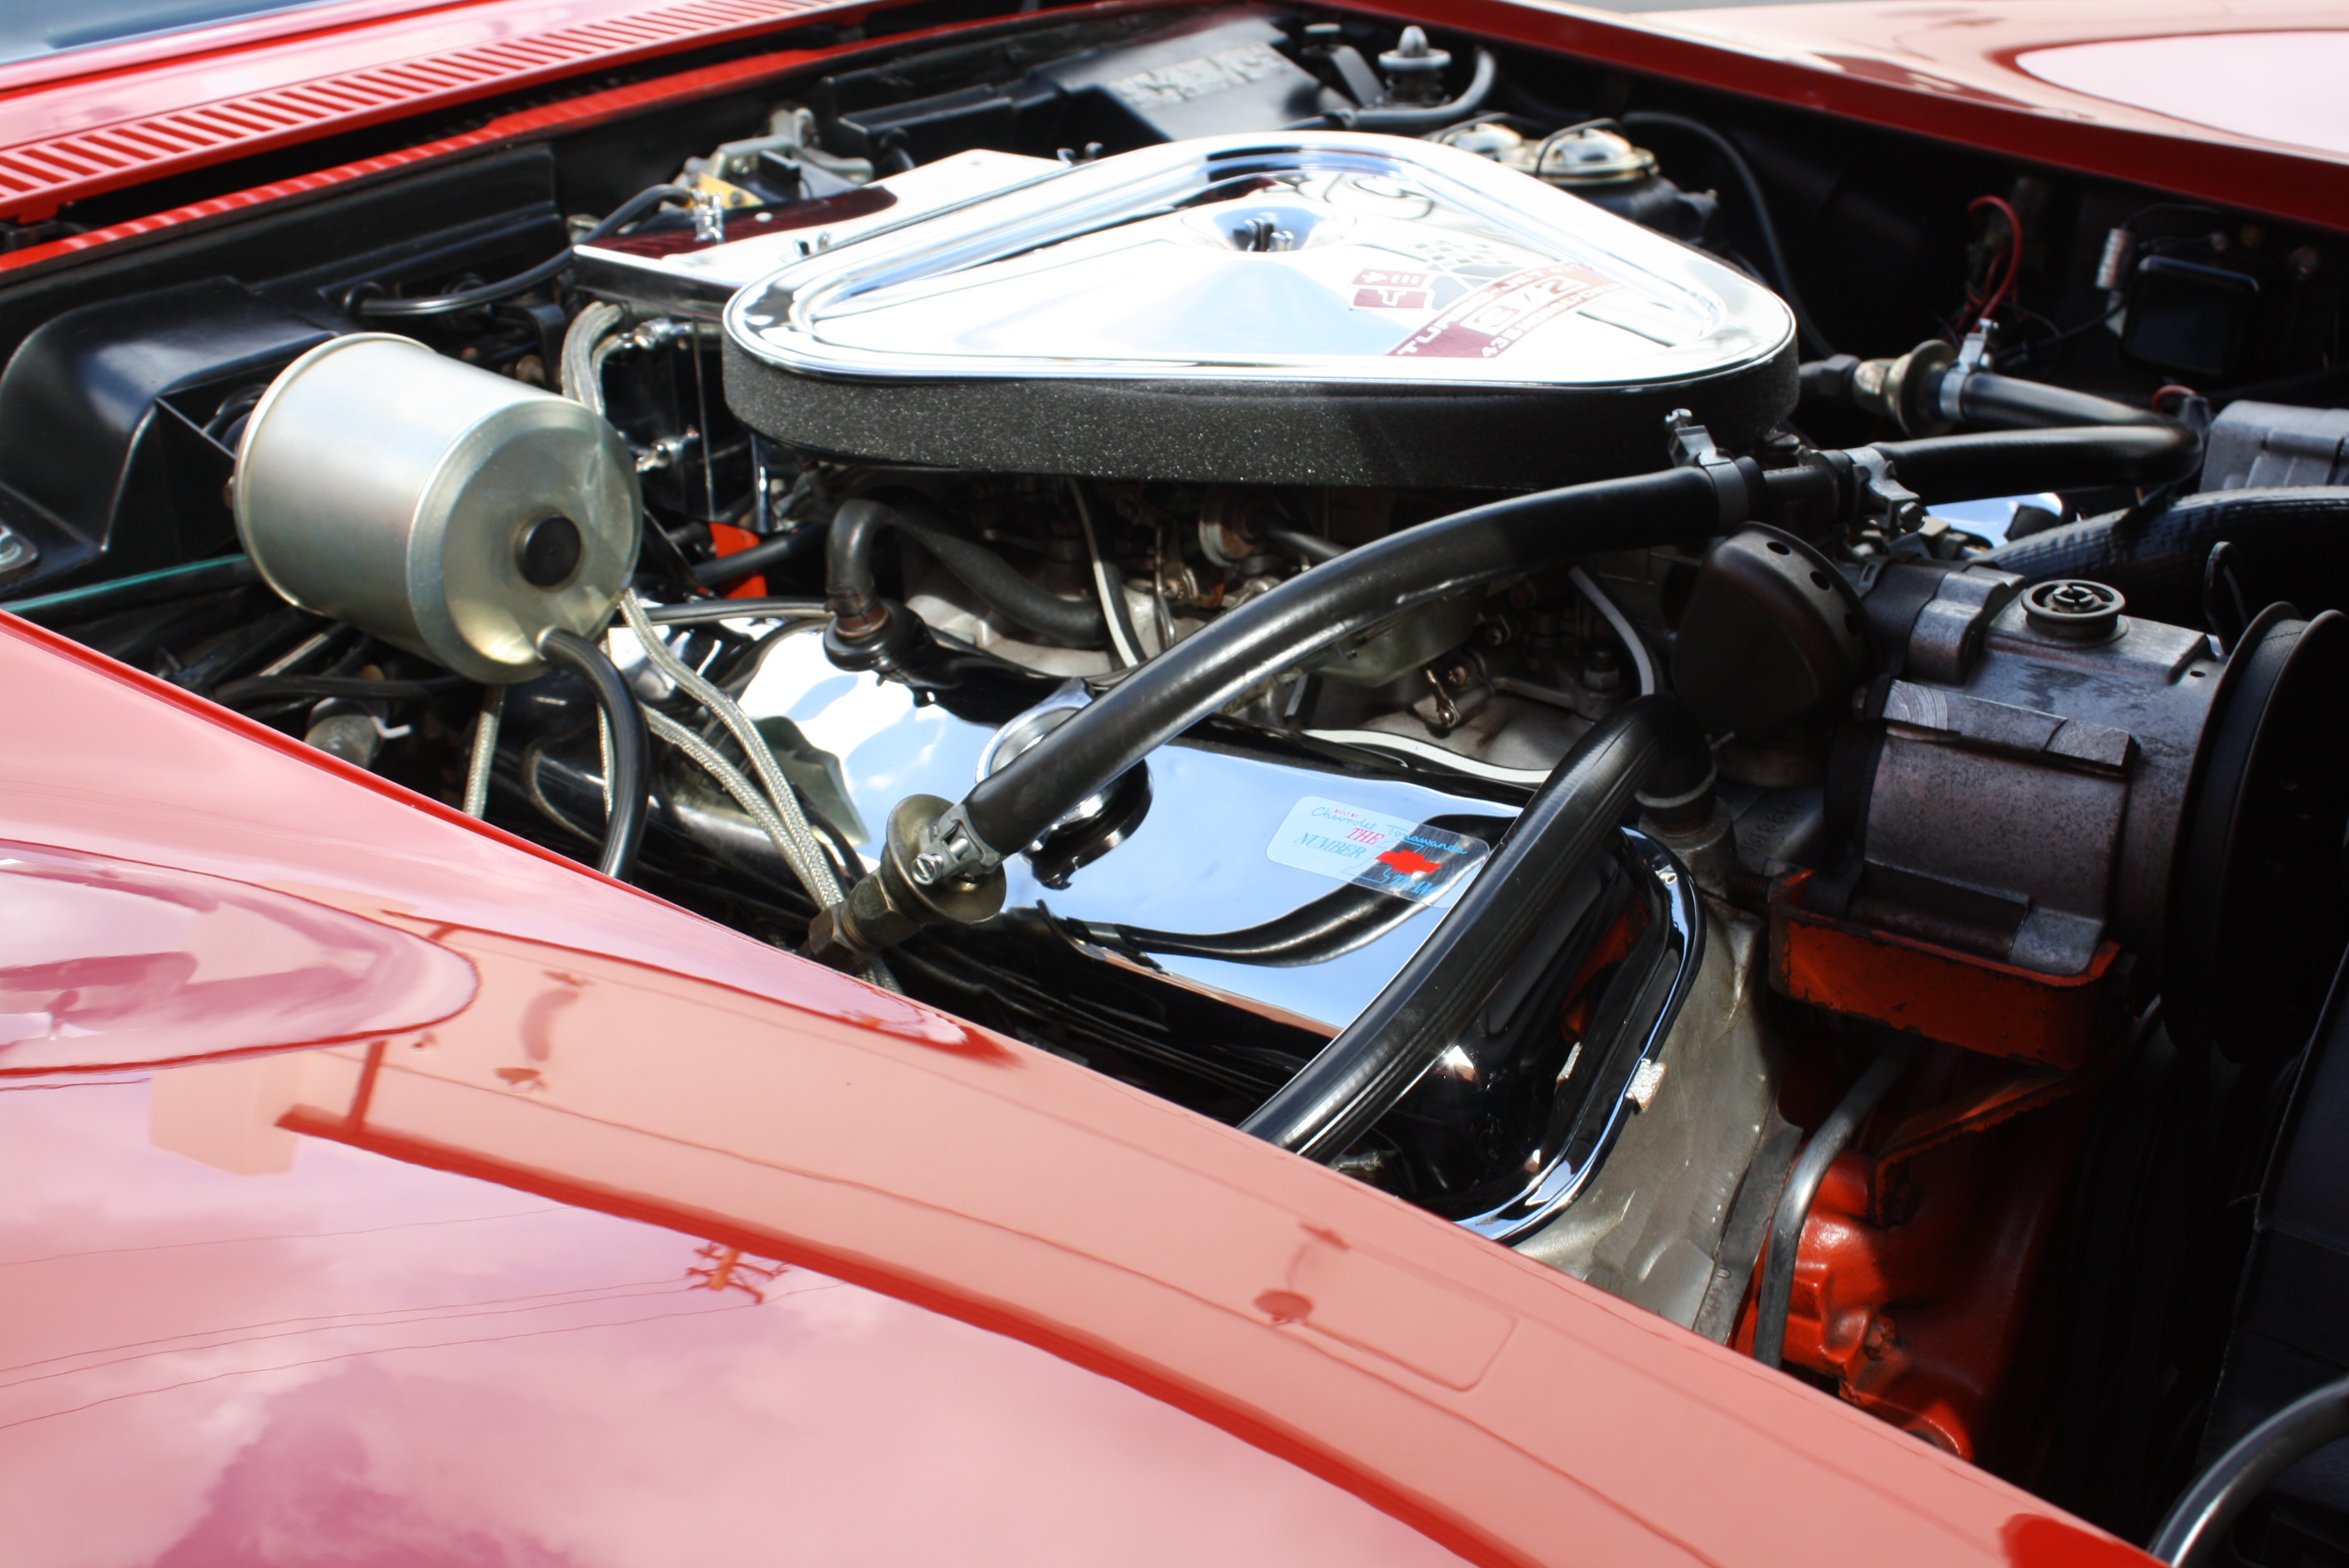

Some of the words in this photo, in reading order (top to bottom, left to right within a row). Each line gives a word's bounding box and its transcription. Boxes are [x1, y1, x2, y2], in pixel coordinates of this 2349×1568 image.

[1396, 269, 1546, 354] TURBO-JET
[1481, 327, 1523, 357] 435
[1310, 807, 1377, 831] Chevrolet
[1386, 823, 1468, 855] Tonawanda
[1344, 827, 1386, 846] THE
[1294, 832, 1368, 860] NUMBER
[1386, 874, 1441, 897] TEAM
